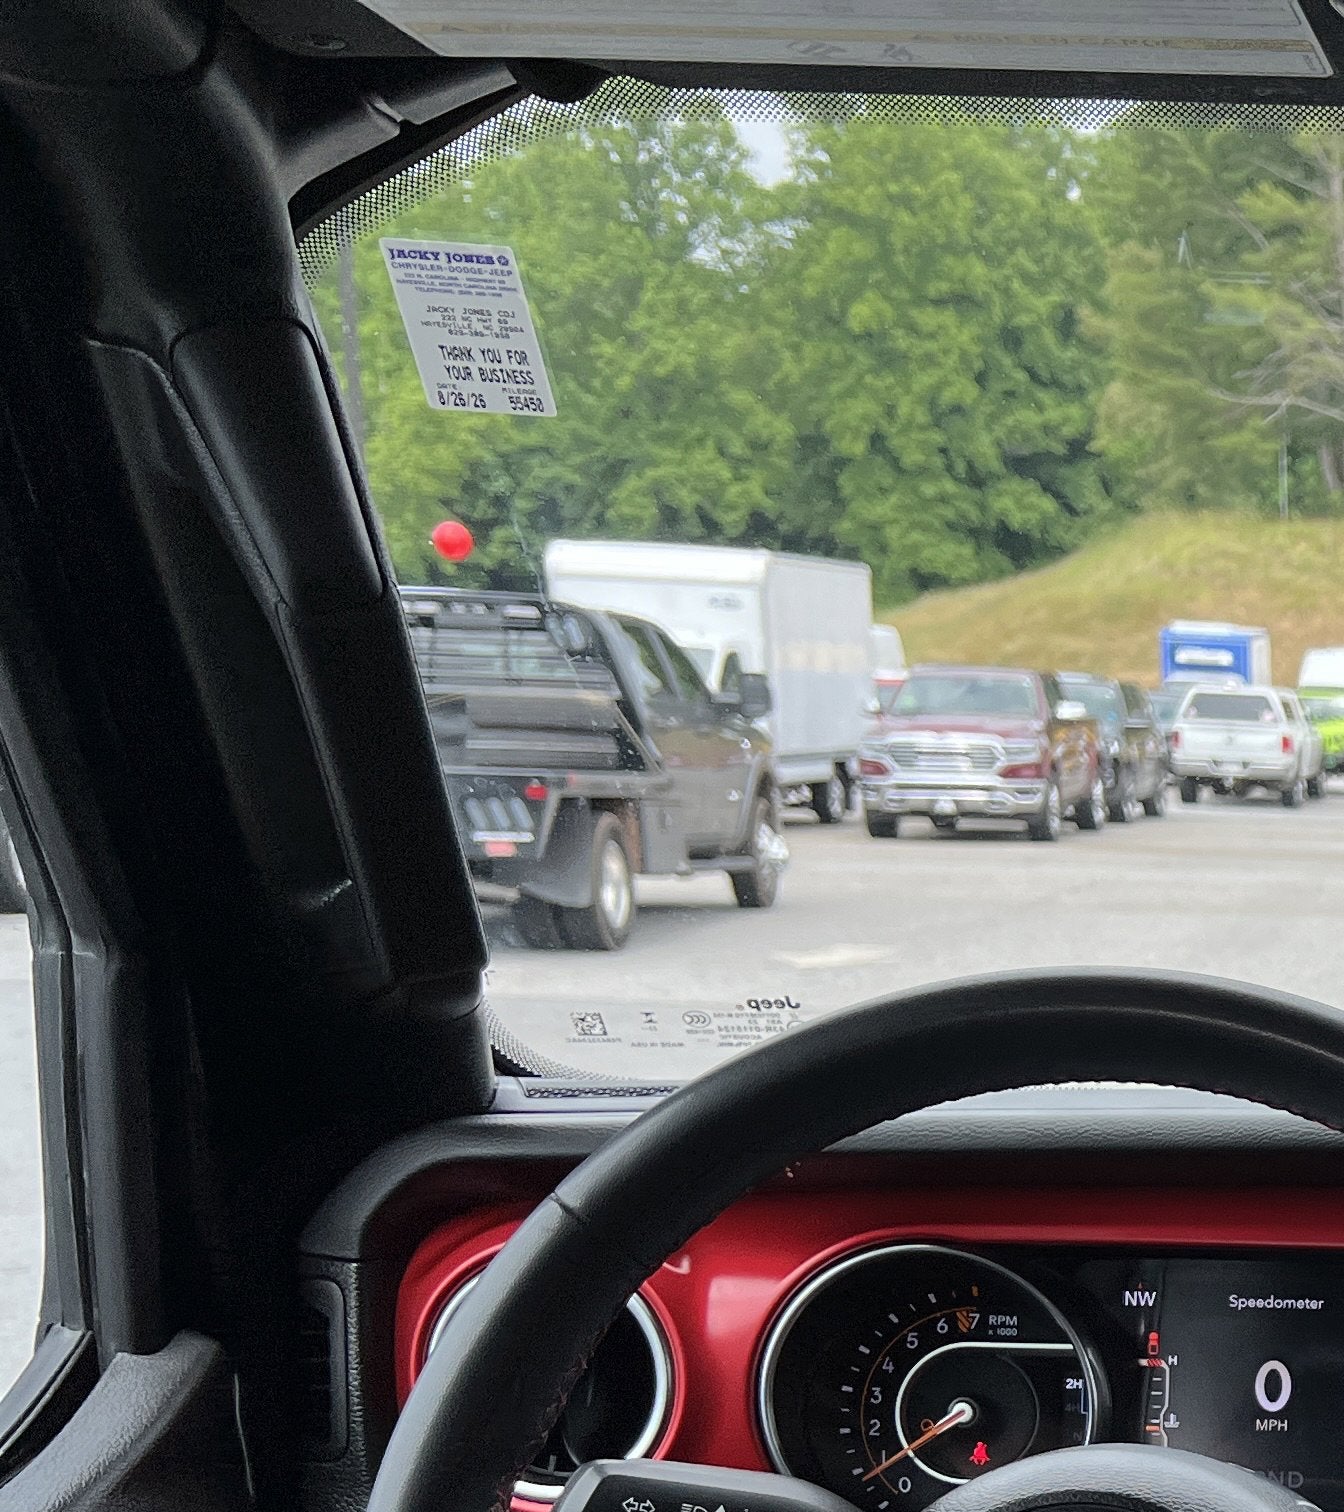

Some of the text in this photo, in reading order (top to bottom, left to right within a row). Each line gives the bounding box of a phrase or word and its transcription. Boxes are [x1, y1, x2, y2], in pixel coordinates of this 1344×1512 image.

[388, 248, 496, 265] JACKY JONES
[426, 305, 455, 314] JACKY
[437, 344, 531, 366] THANK YOU FOR
[443, 364, 535, 385] YOUR BUSINESS
[1123, 1290, 1157, 1307] NW
[1228, 1294, 1325, 1311] Speedometer
[936, 1318, 949, 1334] 6
[968, 1313, 980, 1329] 7
[988, 1315, 1018, 1326] RPM
[906, 1332, 919, 1349] 5
[997, 1328, 1018, 1336] 1000
[882, 1356, 895, 1373] 4
[1168, 1355, 1178, 1366] H
[1065, 1378, 1083, 1390] 2H
[1255, 1360, 1292, 1412] 0
[870, 1387, 882, 1404] 3
[869, 1419, 881, 1436] 2
[1255, 1419, 1288, 1431] MPH
[899, 1477, 912, 1493] 0
